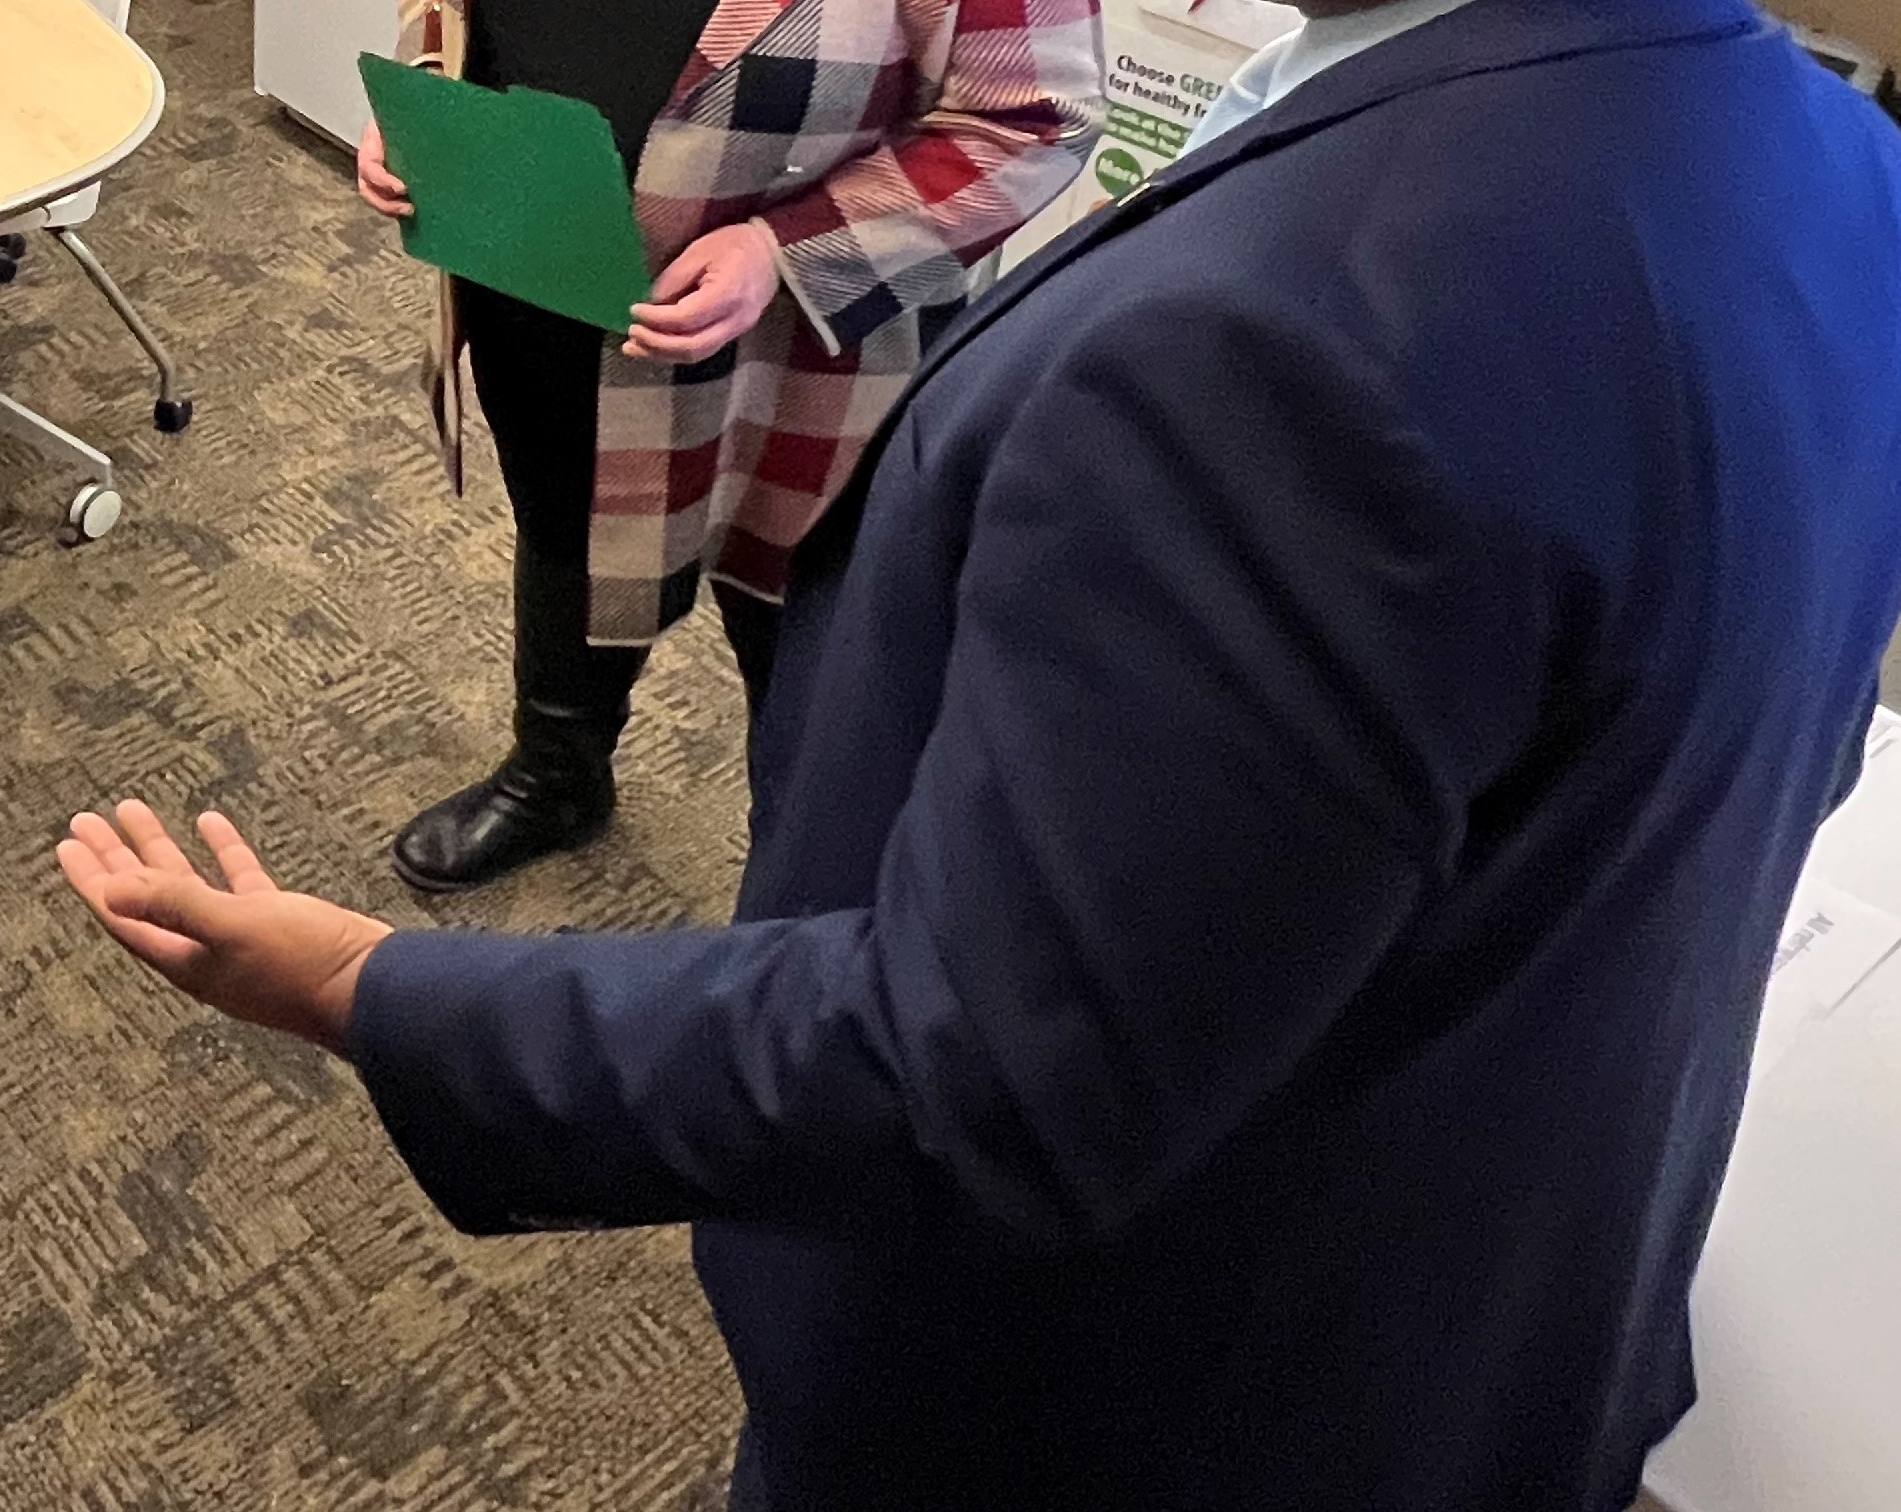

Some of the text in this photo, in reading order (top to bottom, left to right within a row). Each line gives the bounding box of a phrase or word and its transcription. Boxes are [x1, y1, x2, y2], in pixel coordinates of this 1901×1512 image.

[1117, 54, 1175, 86] Choose
[1109, 73, 1130, 93] for
[1132, 81, 1191, 117] healthy
